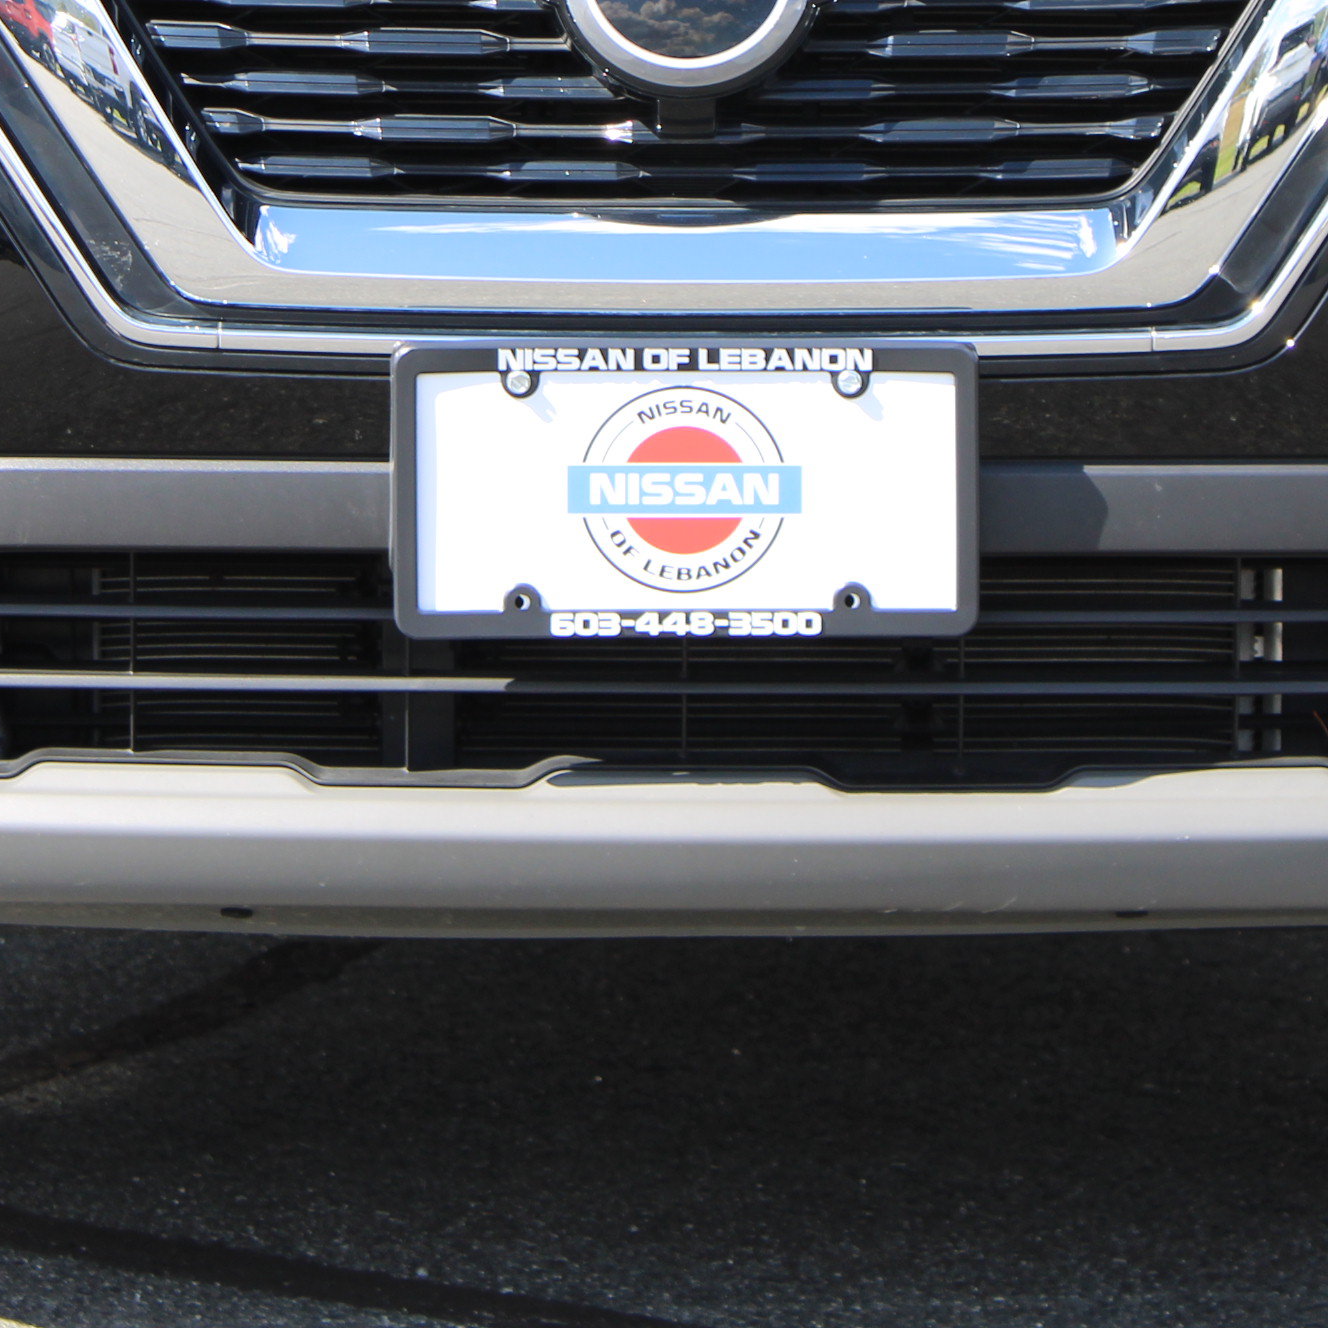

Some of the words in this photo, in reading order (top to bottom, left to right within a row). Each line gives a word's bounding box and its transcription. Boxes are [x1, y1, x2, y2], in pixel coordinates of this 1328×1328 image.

[497, 347, 635, 371] NISSAN
[641, 347, 691, 371] OF
[697, 347, 874, 372] LEBANON
[636, 399, 732, 424] NISSAN
[589, 472, 780, 506] NISSAN
[609, 529, 640, 558] OF
[642, 528, 762, 582] LEBANON
[549, 611, 824, 638] 603-448-3500
